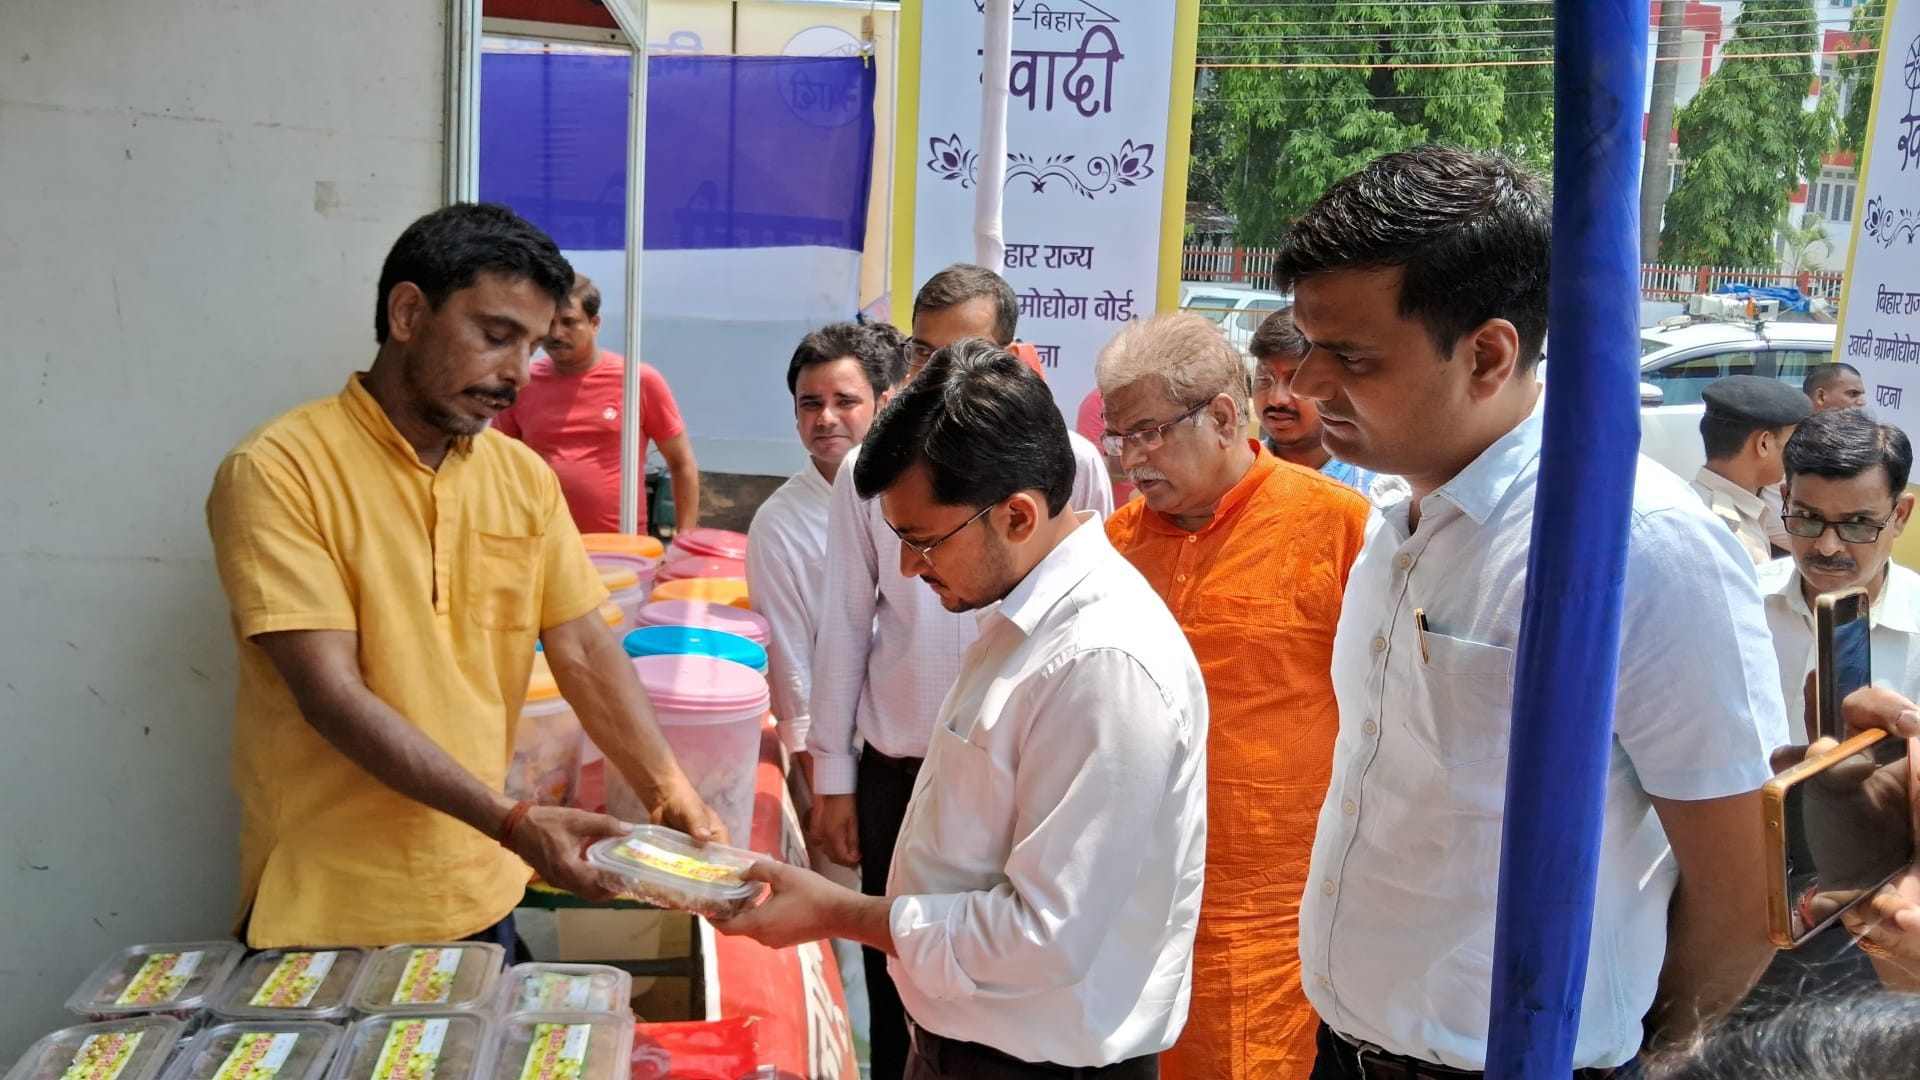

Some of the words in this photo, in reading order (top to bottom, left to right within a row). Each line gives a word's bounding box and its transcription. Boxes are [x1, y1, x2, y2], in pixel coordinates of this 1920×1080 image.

[1032, 3, 1085, 32] बिहार
[1003, 243, 1039, 268] हार
[1043, 245, 1094, 270] राज्य
[1016, 287, 1088, 320] मोद्योग
[1876, 283, 1904, 315] बिहार
[1848, 328, 1873, 358] खादी
[1876, 384, 1902, 410] पटना
